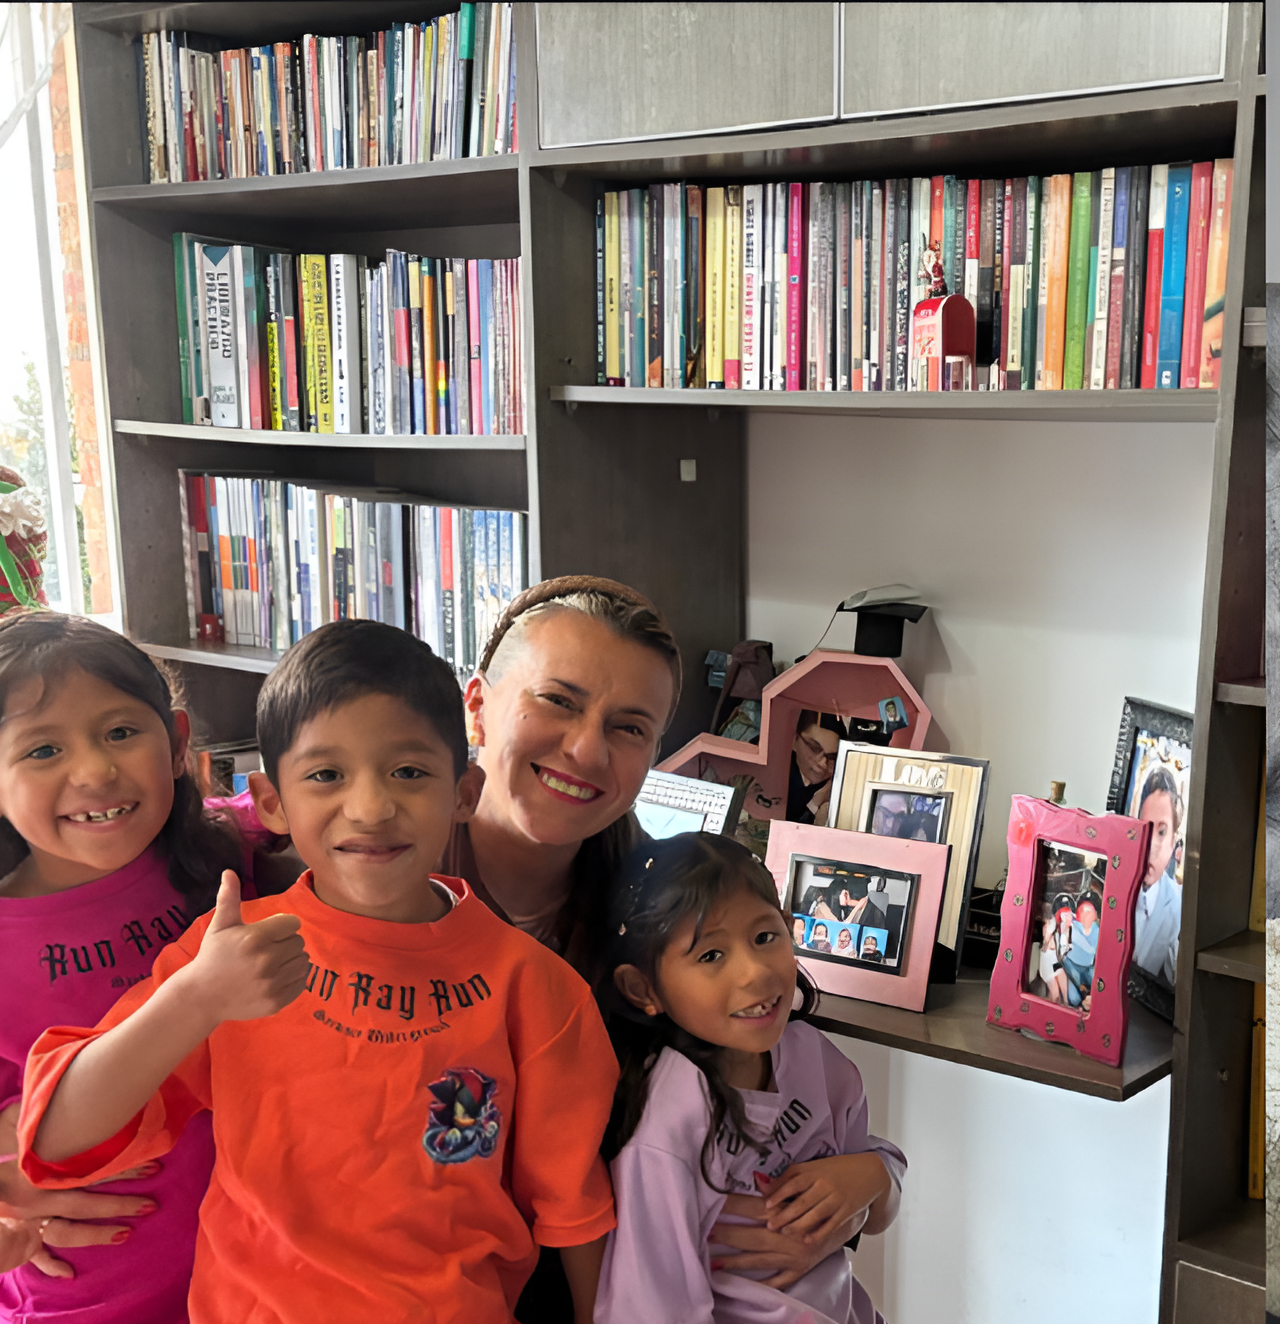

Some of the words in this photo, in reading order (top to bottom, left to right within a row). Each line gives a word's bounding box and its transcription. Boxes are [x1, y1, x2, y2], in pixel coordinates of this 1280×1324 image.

[39, 939, 116, 987] Run
[305, 963, 341, 1002] un
[348, 971, 416, 1021] Ray
[428, 973, 492, 1019] Run
